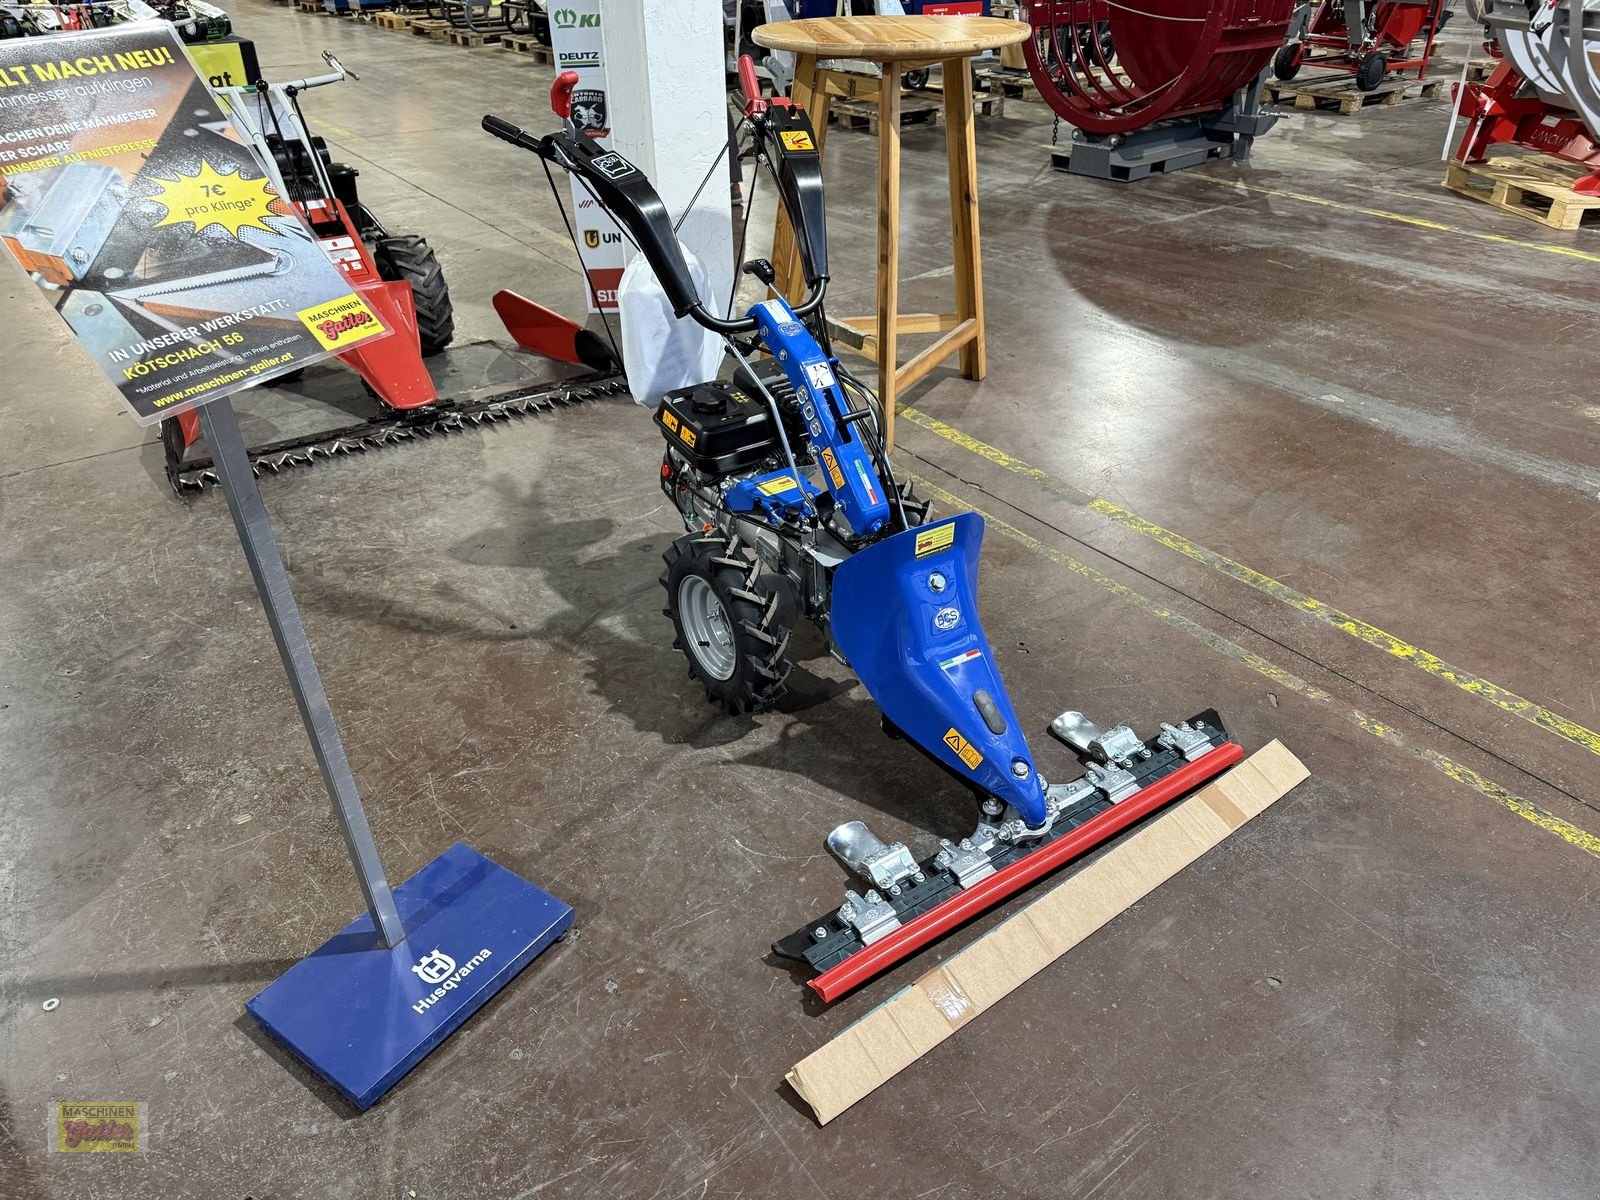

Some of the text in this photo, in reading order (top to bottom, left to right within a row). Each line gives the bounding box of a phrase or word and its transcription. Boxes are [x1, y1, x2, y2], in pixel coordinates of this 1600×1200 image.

[32, 54, 117, 83] MACH
[114, 46, 175, 71] NEU!
[559, 51, 600, 61] DEUTZ
[74, 76, 154, 97] aufklingen
[44, 119, 82, 137] DEINE
[1, 138, 158, 177] UNSERER AUFNIETPRESSE
[19, 139, 71, 159] SCHARF
[200, 184, 226, 197] 7€
[185, 205, 209, 218] pro
[308, 300, 362, 323] MASCHINEN
[108, 298, 290, 363] IN UNSERER WERKSTATT:
[316, 310, 373, 341] Gailer
[122, 331, 244, 380] KÖTSCHACH 56
[172, 372, 189, 383] und
[189, 352, 243, 377] Arbeitsleistung
[251, 345, 270, 356] Preis
[153, 351, 295, 408] www.maschinen-gailer.at
[937, 610, 958, 626] BCS
[412, 948, 493, 1015] Husqvarna
